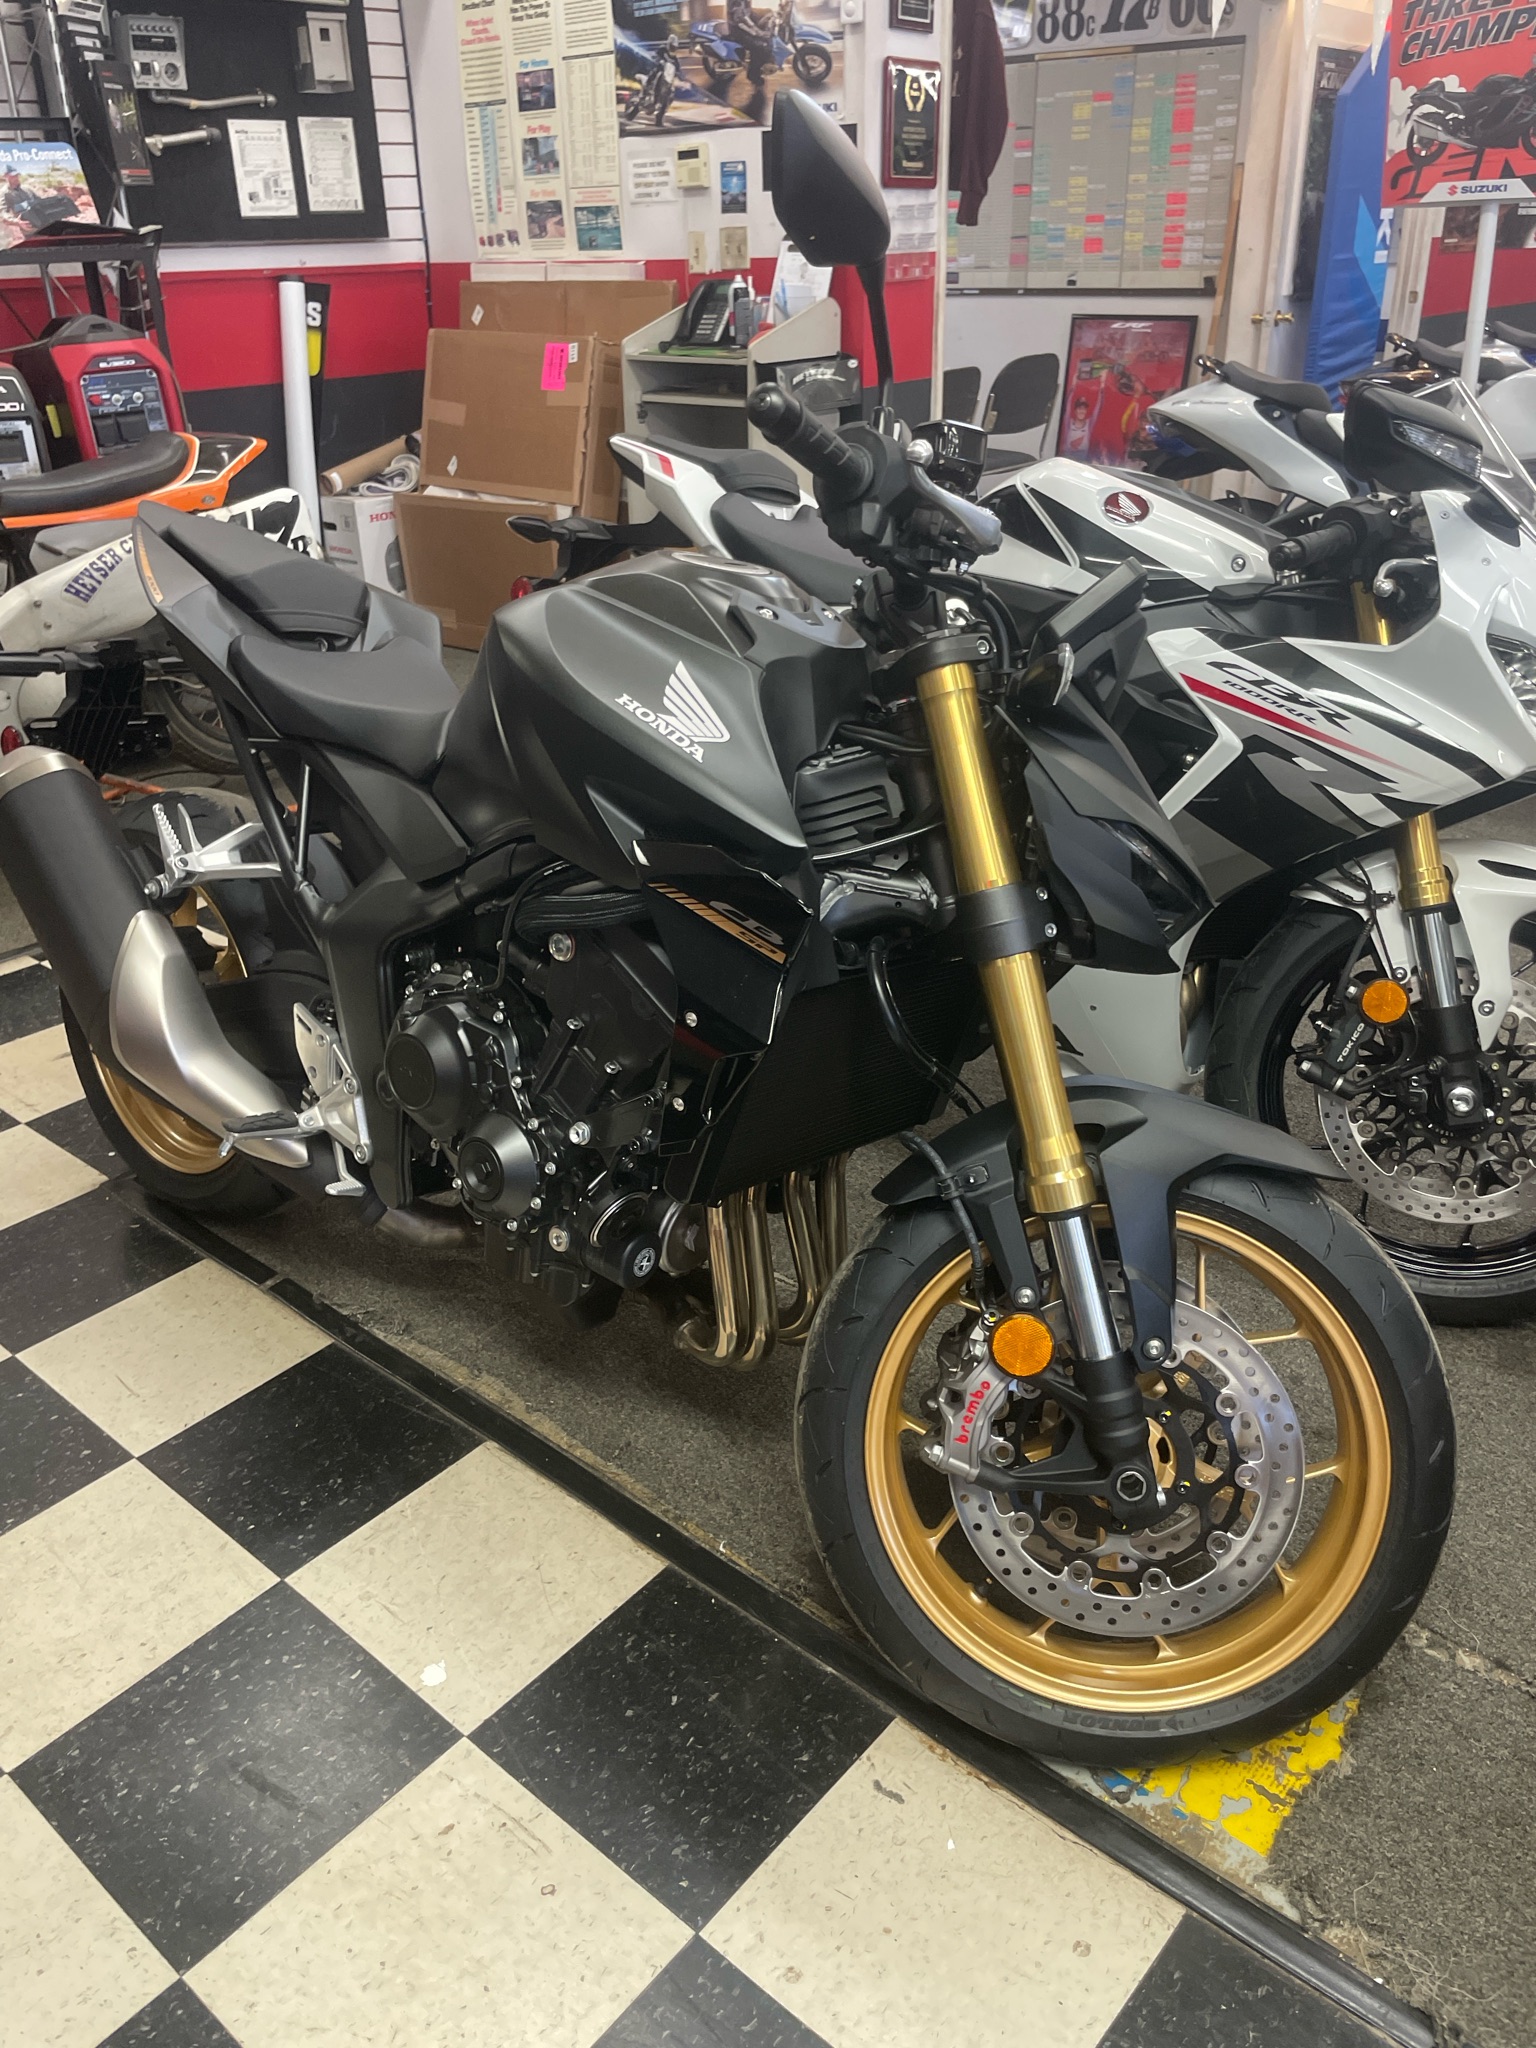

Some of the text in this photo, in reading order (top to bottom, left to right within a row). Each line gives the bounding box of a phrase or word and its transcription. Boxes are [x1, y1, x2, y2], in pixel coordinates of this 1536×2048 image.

[1402, 0, 1514, 32] THRE
[12, 148, 74, 160] Pro-Connect
[1461, 184, 1508, 194] SUZUKI
[64, 547, 123, 603] HEYSER
[1206, 661, 1352, 734] CBR
[1222, 680, 1317, 725] 1000RR
[614, 693, 704, 763] HONDA
[709, 901, 784, 945] CB
[738, 931, 778, 954] SP
[1337, 1022, 1365, 1063] TOKICO
[953, 1381, 991, 1445] brembo
